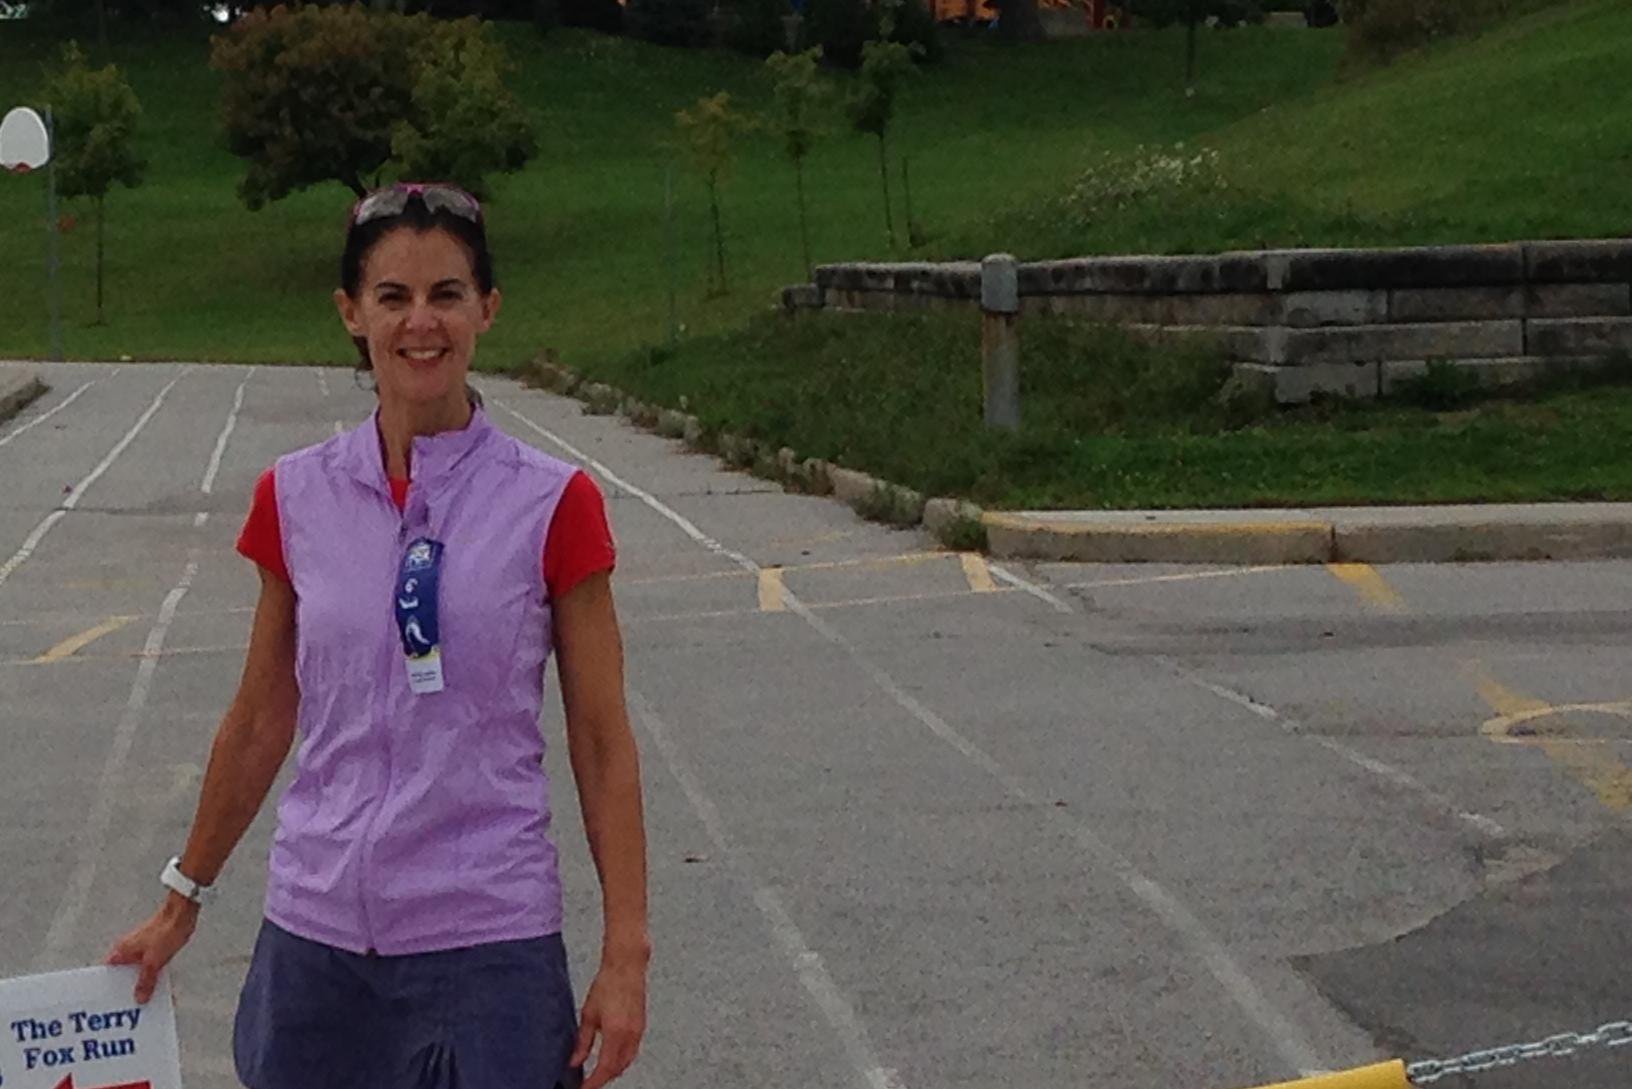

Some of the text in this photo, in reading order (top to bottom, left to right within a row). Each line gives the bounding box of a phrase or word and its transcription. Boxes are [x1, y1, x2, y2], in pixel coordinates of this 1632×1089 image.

[11, 1007, 141, 1043] The Terry
[24, 1036, 136, 1070] Fox Run
